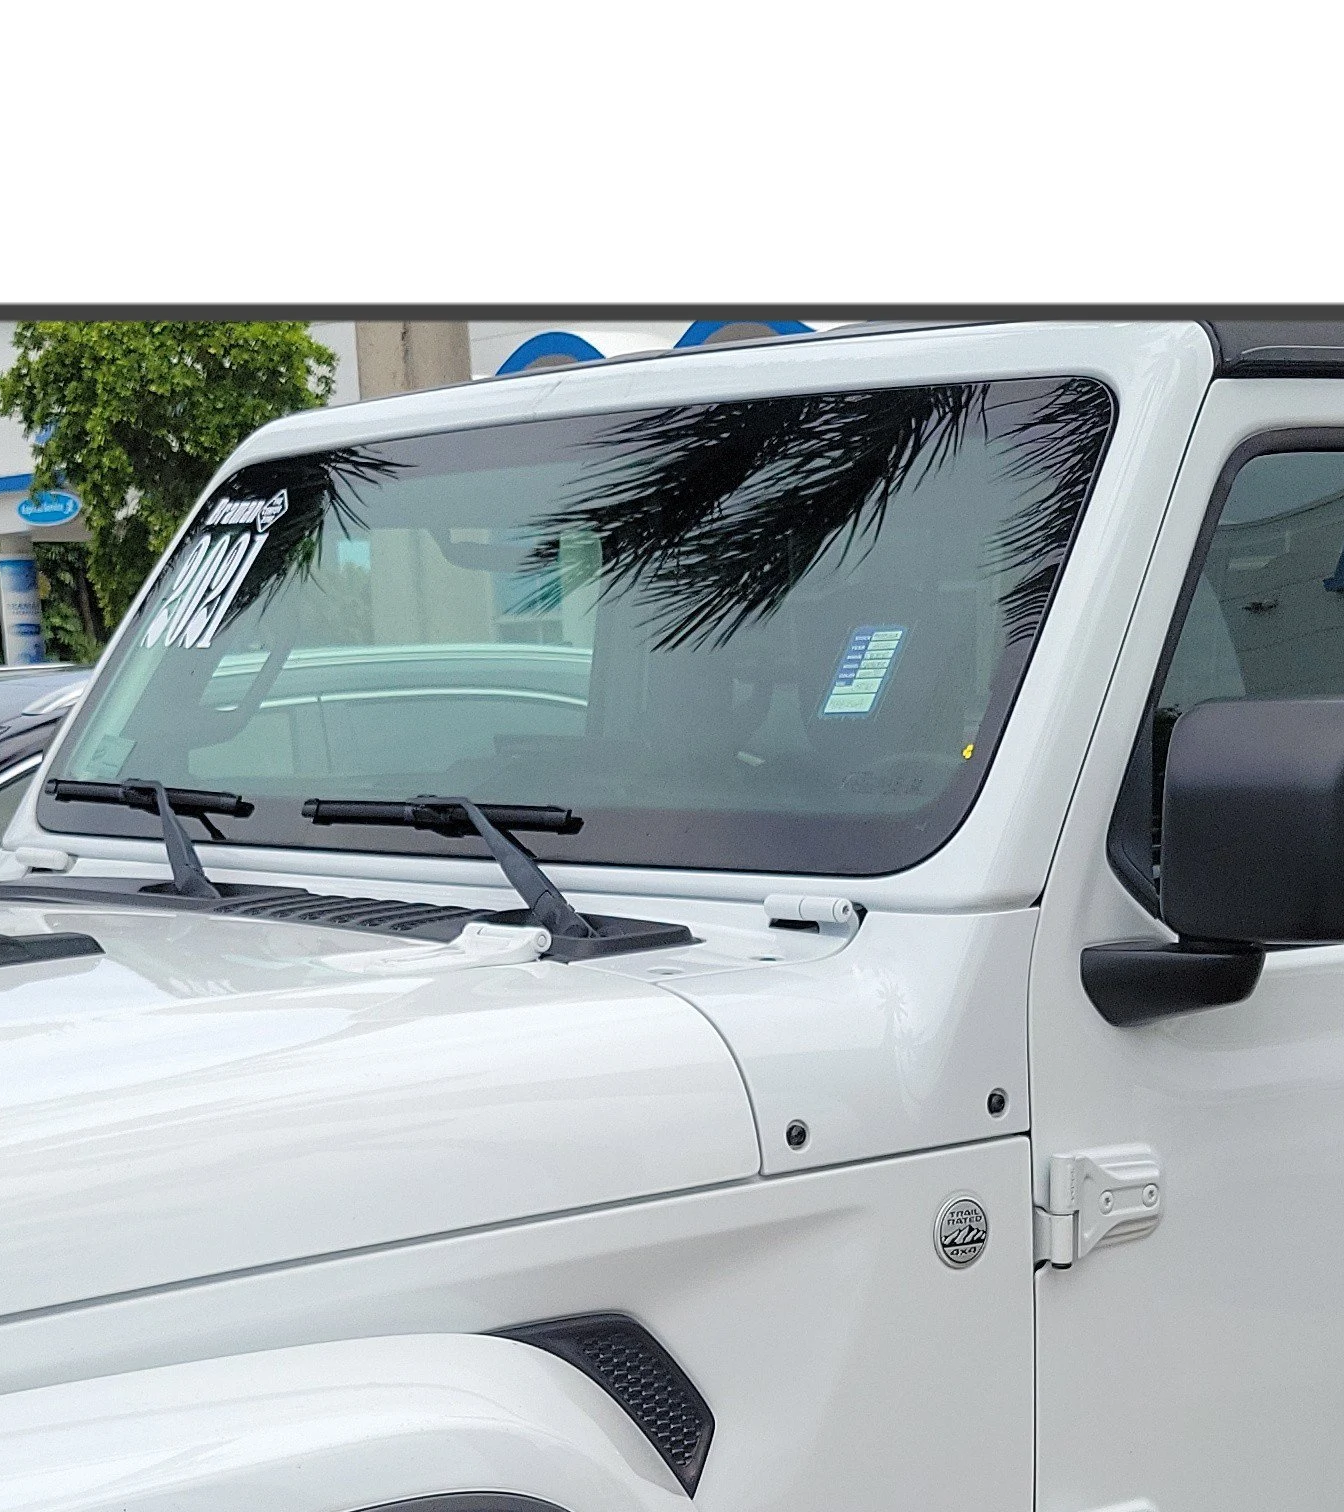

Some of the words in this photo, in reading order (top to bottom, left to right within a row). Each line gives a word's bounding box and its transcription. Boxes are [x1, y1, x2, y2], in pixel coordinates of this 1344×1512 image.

[140, 531, 270, 648] 2021
[950, 1209, 979, 1218] TRAIL
[947, 1216, 983, 1225] RATED
